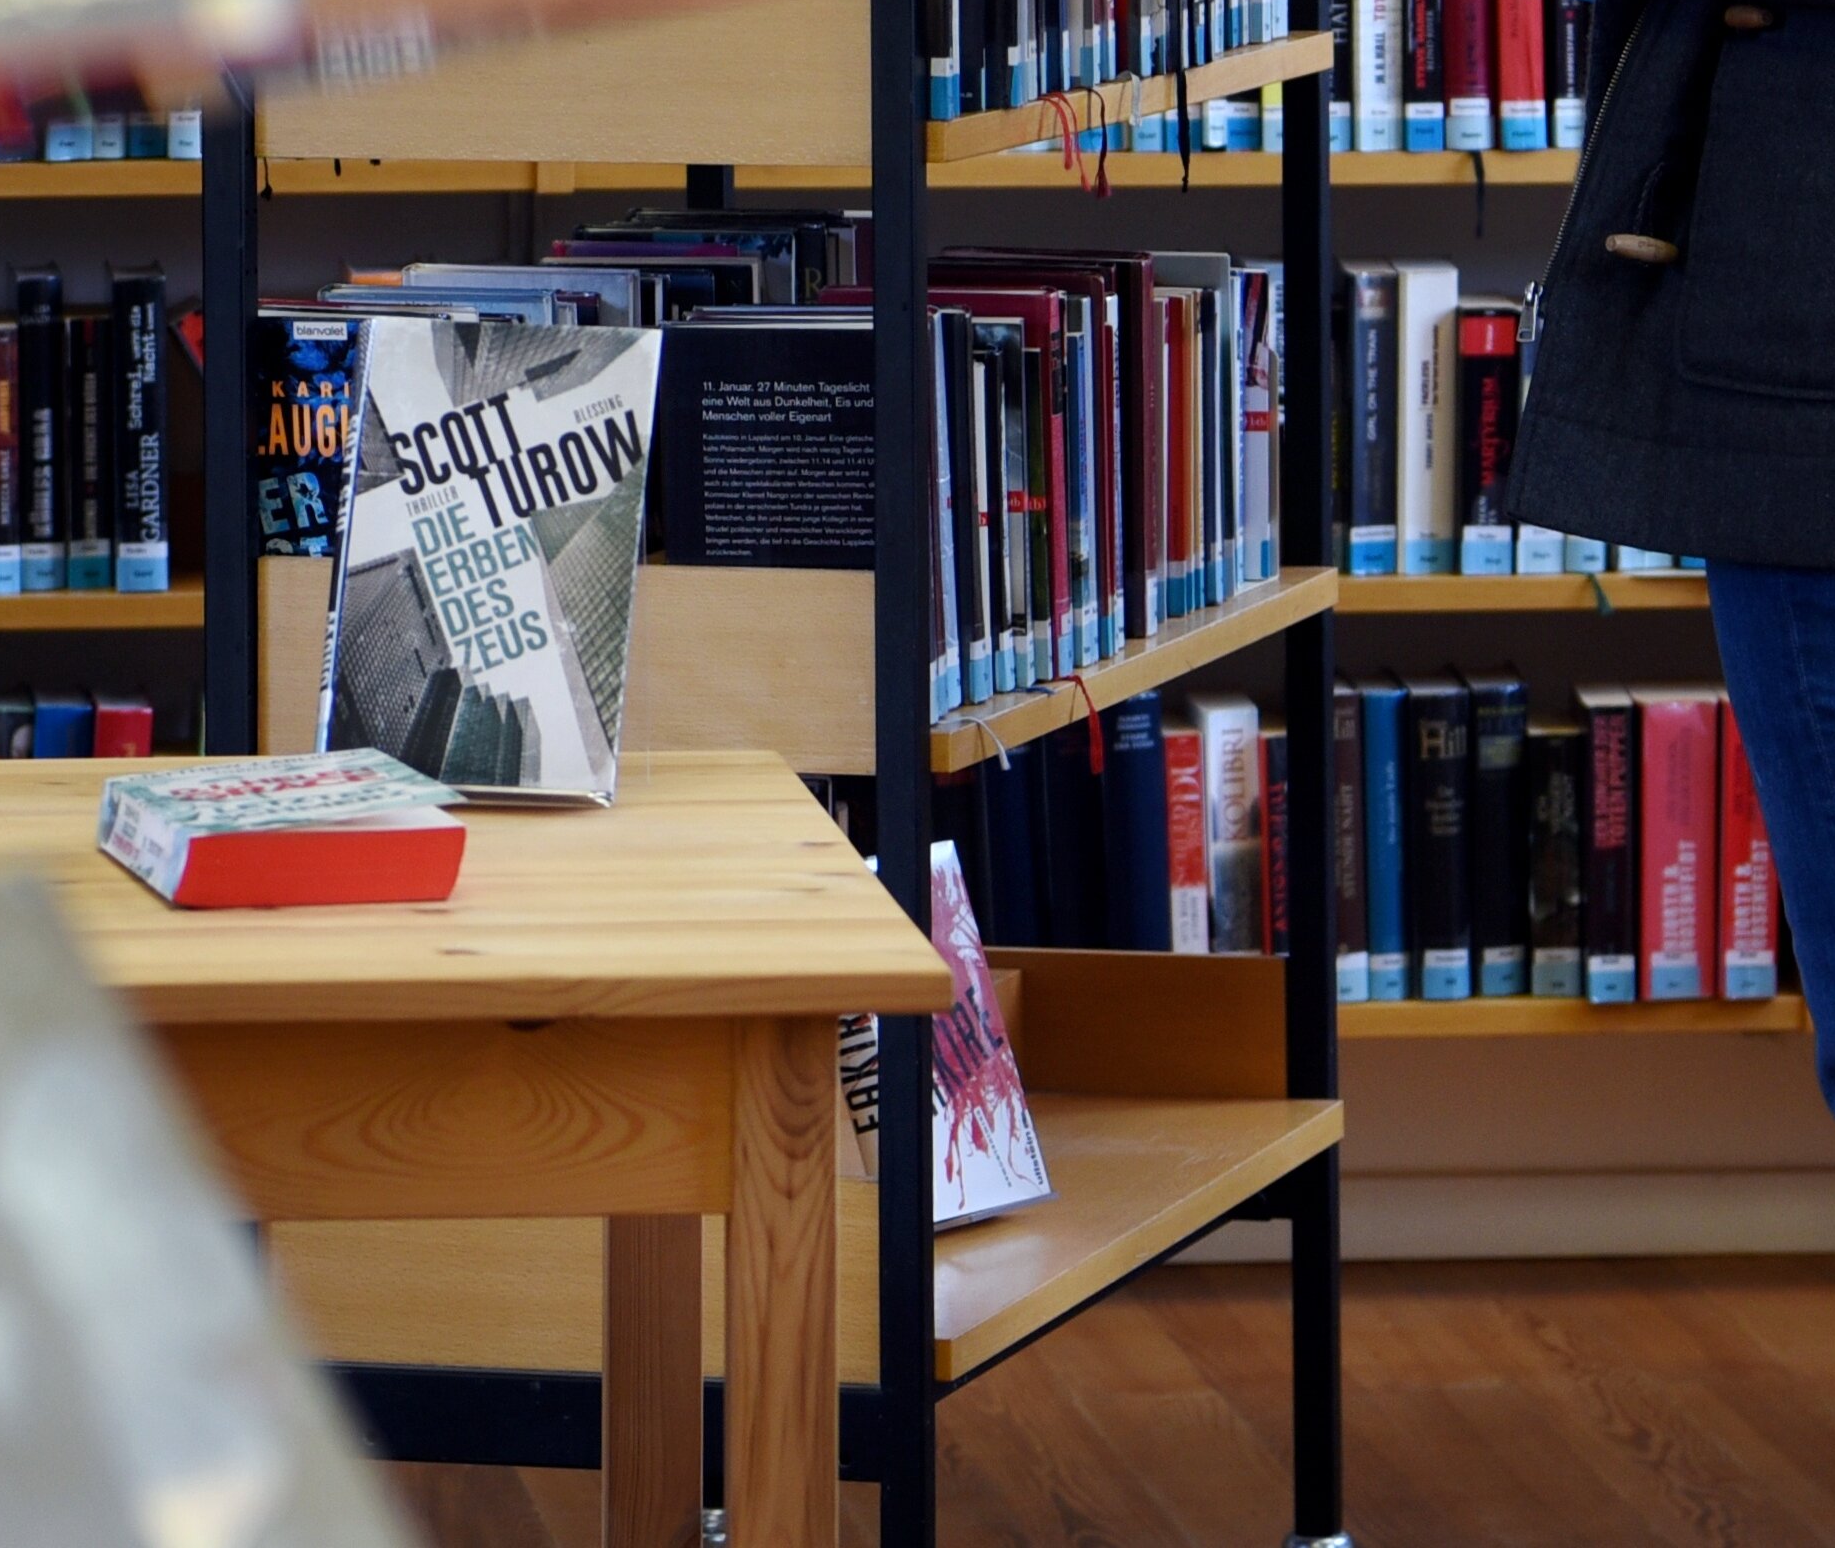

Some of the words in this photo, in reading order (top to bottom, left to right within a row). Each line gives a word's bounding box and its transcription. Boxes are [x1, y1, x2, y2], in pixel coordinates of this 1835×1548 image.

[130, 305, 142, 328] die
[296, 325, 345, 338] blanvalet
[143, 332, 157, 382] Nacht
[1367, 328, 1377, 364] TRAIN
[127, 363, 143, 430] Schrei,
[702, 396, 724, 406] eine
[726, 395, 751, 407] Welt
[753, 397, 772, 407] aus
[774, 396, 832, 409] Dunkelheit,
[835, 396, 852, 408] Eis
[854, 396, 875, 408] und
[703, 381, 716, 392] 11.
[718, 381, 754, 393] Januar.
[756, 381, 771, 393] 27
[774, 381, 816, 393] Minuten
[817, 381, 870, 395] Tageslicht
[1367, 367, 1377, 390] THE
[573, 393, 624, 424] BLESSING
[702, 409, 756, 422] Menschen
[758, 410, 786, 422] voller
[788, 410, 832, 425] Eigenart
[390, 392, 525, 495] SCOTT
[125, 469, 140, 508] LISA
[140, 432, 160, 540] GARDNER
[471, 410, 643, 528] TUROW
[405, 485, 461, 518] THRILLER
[411, 500, 476, 556] DIE
[424, 522, 539, 597] ERBEN
[439, 578, 515, 638] DES
[454, 609, 548, 675] ZEUS
[1222, 727, 1247, 841] KOLIBRI
[1025, 1131, 1044, 1185] ullstein
